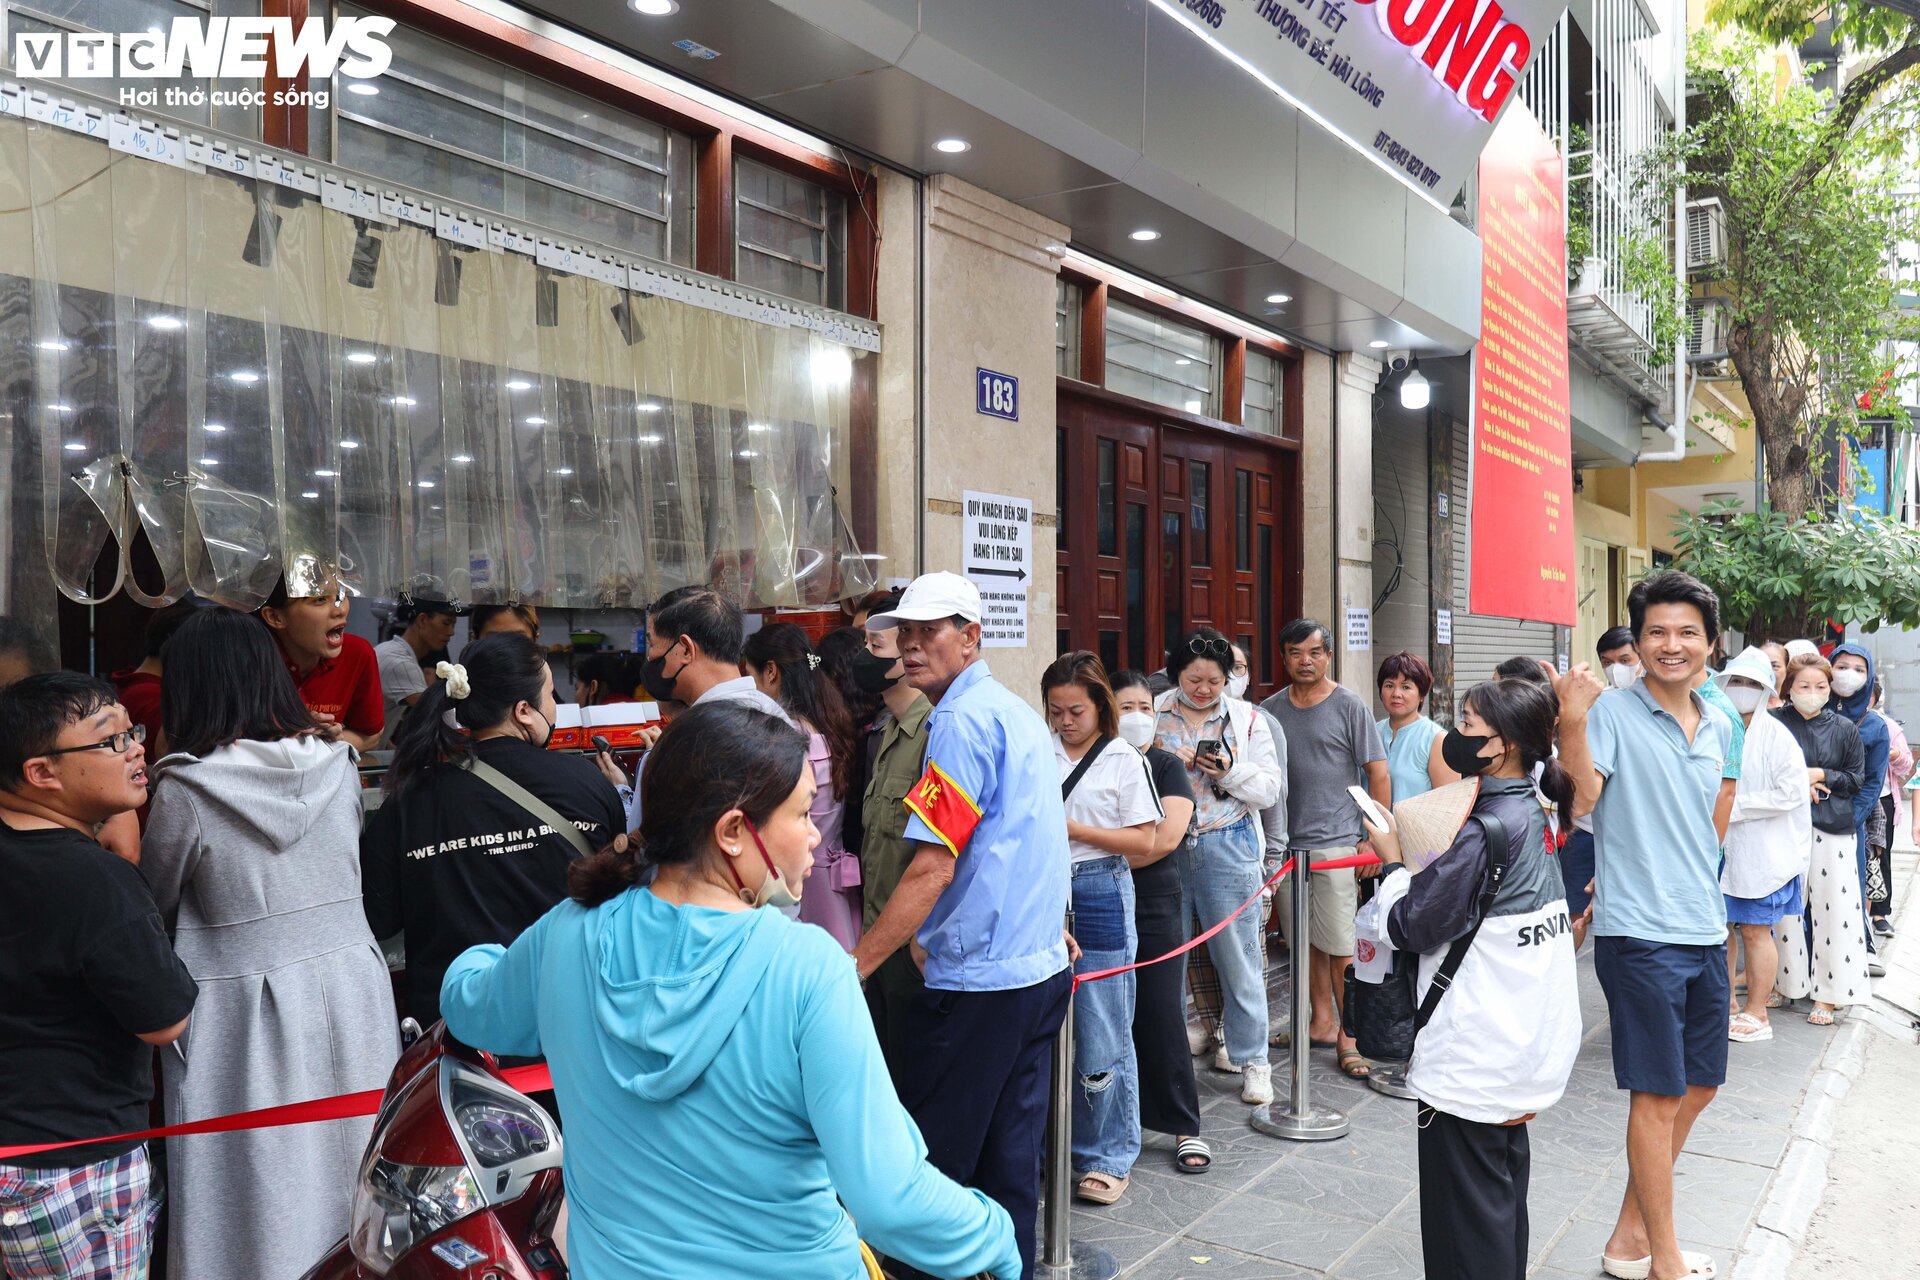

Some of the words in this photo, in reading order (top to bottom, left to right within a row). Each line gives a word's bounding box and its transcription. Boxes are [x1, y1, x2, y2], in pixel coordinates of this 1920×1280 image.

[1254, 0, 1311, 50] THƯỢNG
[87, 118, 98, 134] D
[156, 139, 167, 156] D
[234, 158, 245, 172] D
[1406, 154, 1425, 178] 823
[1420, 166, 1442, 190] 0797
[397, 206, 412, 219] 12
[502, 237, 514, 249] 10
[982, 375, 1014, 414] 183
[967, 498, 981, 518] QUÝ
[981, 500, 1004, 520] KHÁCH
[1003, 500, 1016, 521] ĐẾN
[1016, 506, 1029, 522] SAU
[978, 522, 990, 538] VUI
[990, 521, 1007, 541] LÒNG
[1007, 522, 1019, 542] XẾP
[973, 540, 991, 560] HÀNG
[991, 545, 996, 560] 1
[996, 544, 1011, 562] PHÍA
[1011, 546, 1024, 563] SAU
[919, 777, 942, 809] VỆ
[439, 838, 468, 853] ARE
[470, 832, 505, 847] KIDS
[507, 829, 523, 842] IN
[526, 827, 537, 839] A
[488, 848, 504, 856] THE
[505, 842, 534, 853] WEIRD
